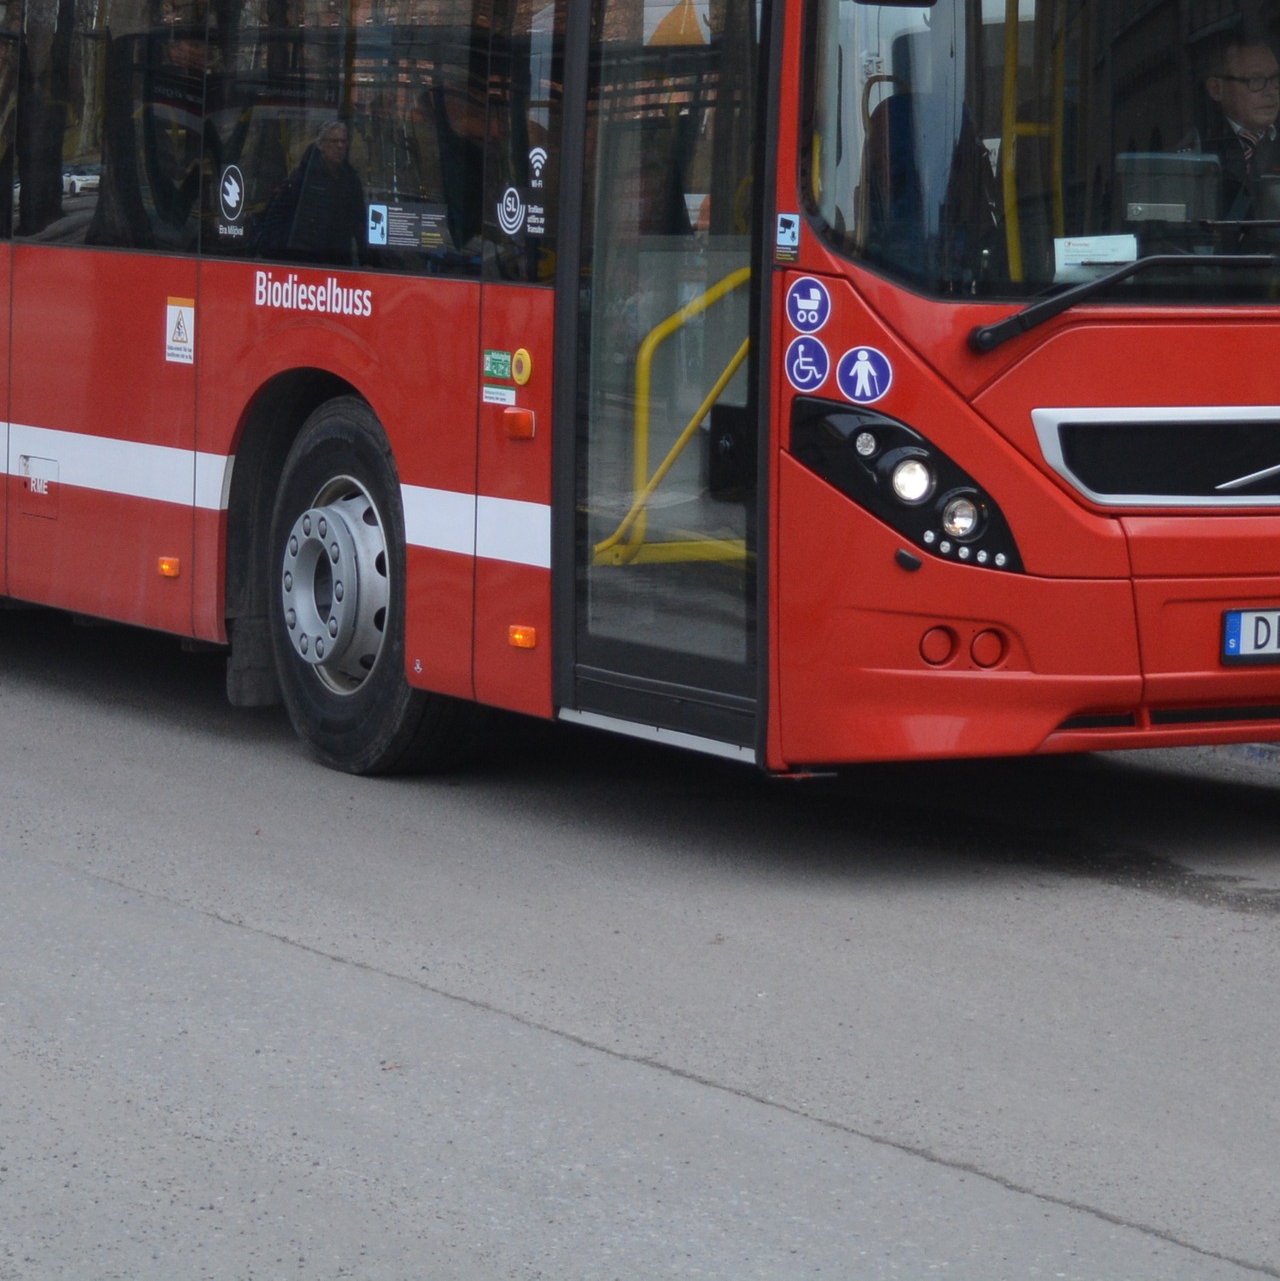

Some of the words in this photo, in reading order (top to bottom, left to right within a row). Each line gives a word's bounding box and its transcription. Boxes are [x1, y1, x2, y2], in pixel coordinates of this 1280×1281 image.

[506, 197, 517, 212] SL
[255, 271, 372, 317] Biodieselbuss
[30, 478, 48, 495] RME
[1229, 639, 1236, 649] S
